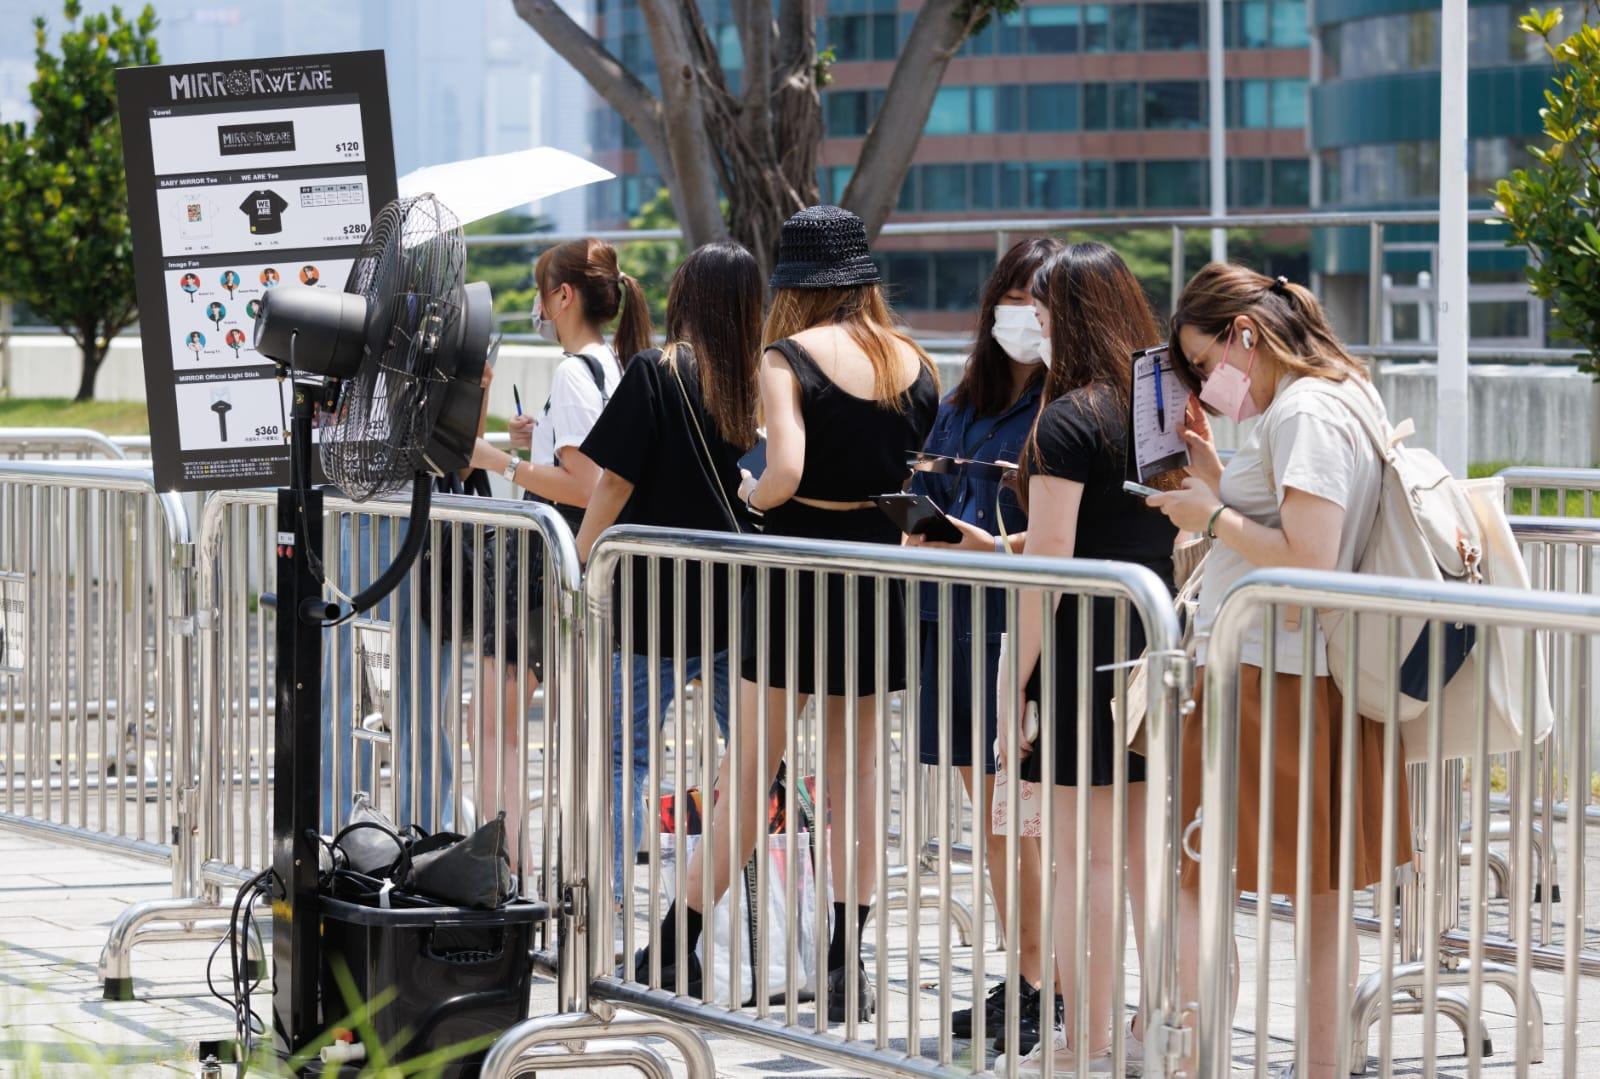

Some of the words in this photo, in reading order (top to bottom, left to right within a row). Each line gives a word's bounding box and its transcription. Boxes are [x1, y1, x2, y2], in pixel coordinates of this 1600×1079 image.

[335, 141, 359, 152] $120
[252, 173, 267, 181] ARE
[160, 179, 179, 187] BABY
[179, 178, 206, 186] MIRROR
[257, 200, 270, 208] WE
[343, 223, 367, 234] $280
[168, 261, 188, 269] Image
[227, 372, 244, 380] Light
[255, 425, 278, 436] $360
